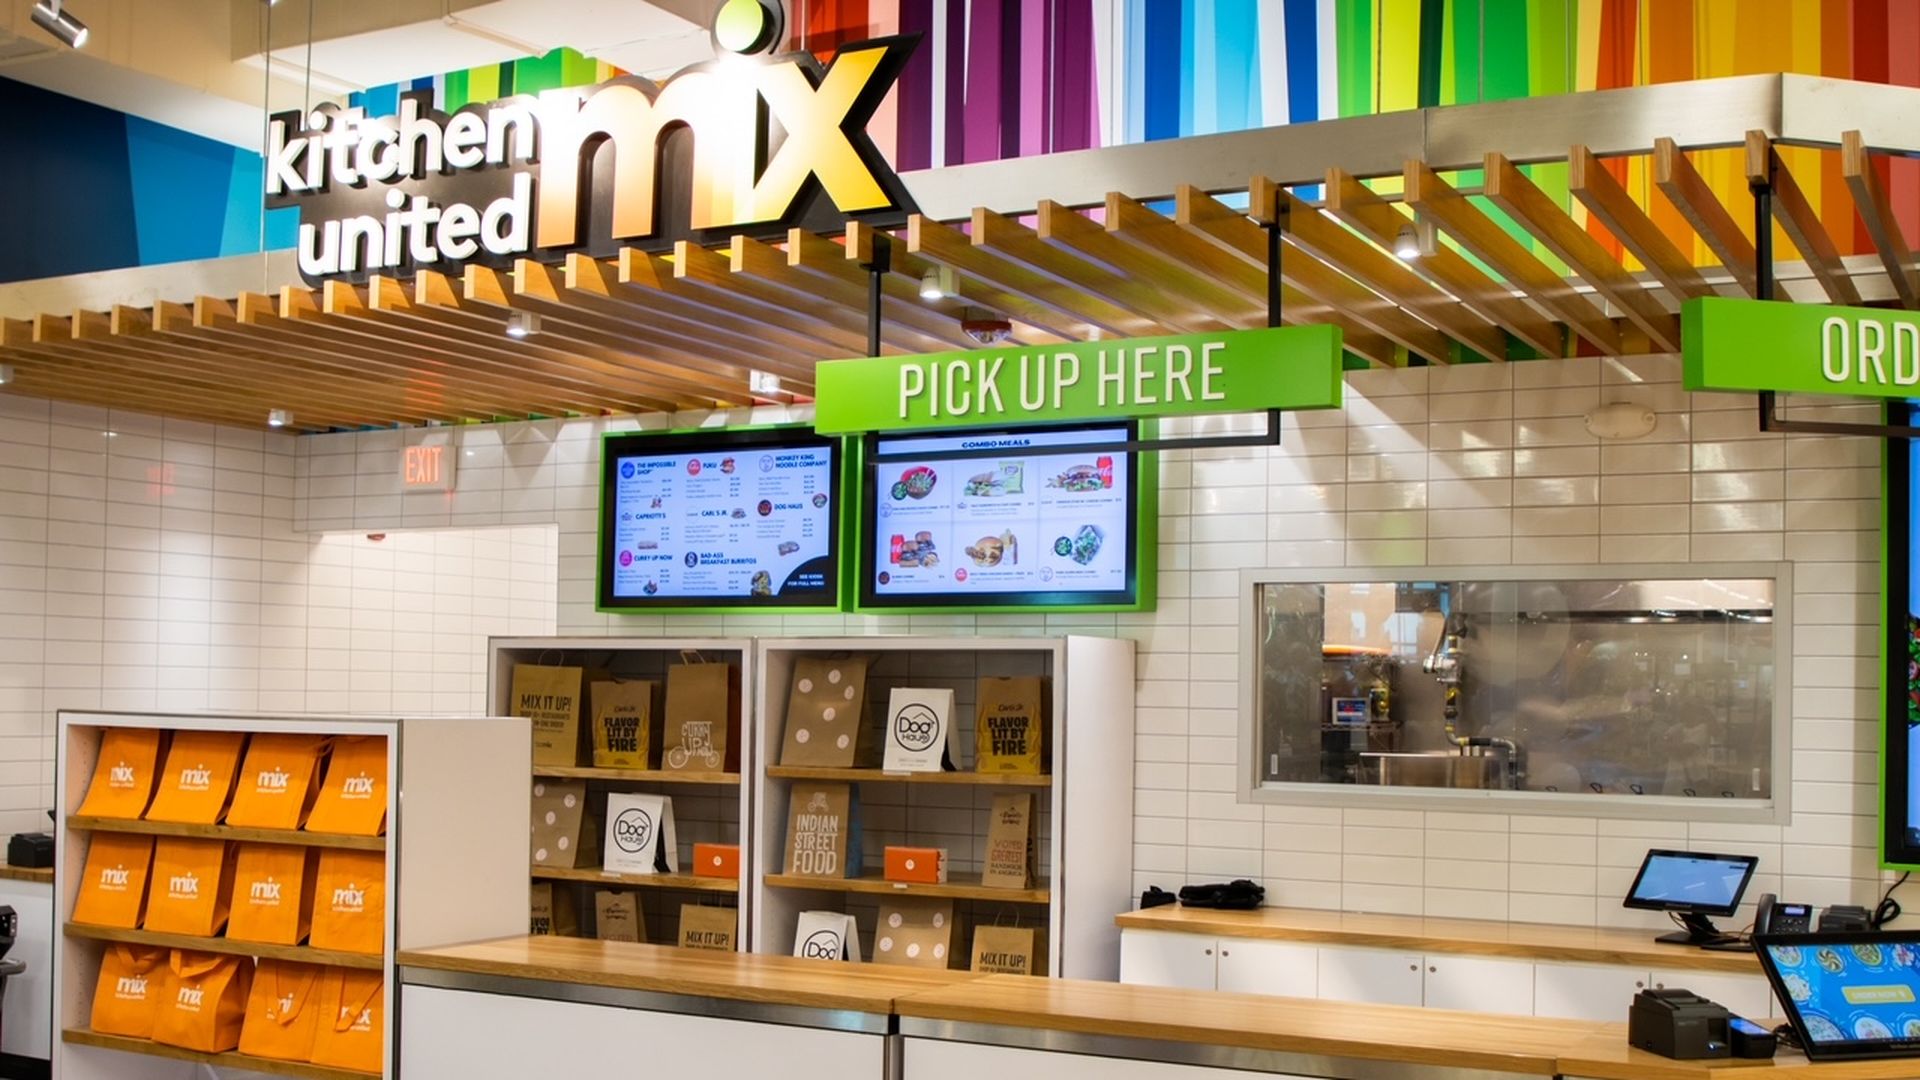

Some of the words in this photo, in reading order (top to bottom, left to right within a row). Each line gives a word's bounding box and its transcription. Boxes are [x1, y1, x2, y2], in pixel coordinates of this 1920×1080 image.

[537, 0, 892, 249] mix
[266, 97, 540, 194] kitchen
[299, 172, 531, 276] united
[1822, 316, 1920, 385] ORD
[899, 357, 1006, 419] PICK
[1019, 352, 1080, 411] UP
[1097, 341, 1227, 407] HERE
[961, 440, 997, 449] COMBO
[998, 439, 1031, 447] MEALS
[405, 447, 442, 483] EXIT
[800, 460, 828, 468] COMPANY
[520, 694, 541, 709] MIX
[543, 696, 554, 710] IT
[604, 717, 640, 727] FLAVOR
[899, 716, 932, 737] Dog
[988, 716, 1029, 728] FLAVOR
[607, 728, 621, 737] LIT
[623, 728, 637, 737] BY
[992, 728, 1008, 739] LIT
[1010, 728, 1026, 739] BY
[608, 738, 637, 752] FIRE
[993, 740, 1027, 756] FIRE
[180, 764, 212, 785] mix
[257, 766, 290, 788] mix
[343, 771, 374, 793] mix
[618, 820, 645, 838] Dog
[796, 814, 839, 832] INDIAN
[795, 831, 838, 850] STREET
[793, 850, 837, 875] FOOD
[100, 864, 130, 885] mix
[170, 872, 199, 893] mix
[251, 876, 281, 899] mix
[332, 883, 365, 906] mix
[686, 931, 703, 944] MIX
[704, 931, 714, 944] IT
[979, 952, 997, 965] MIX
[998, 953, 1008, 966] IT
[117, 974, 148, 993] mix
